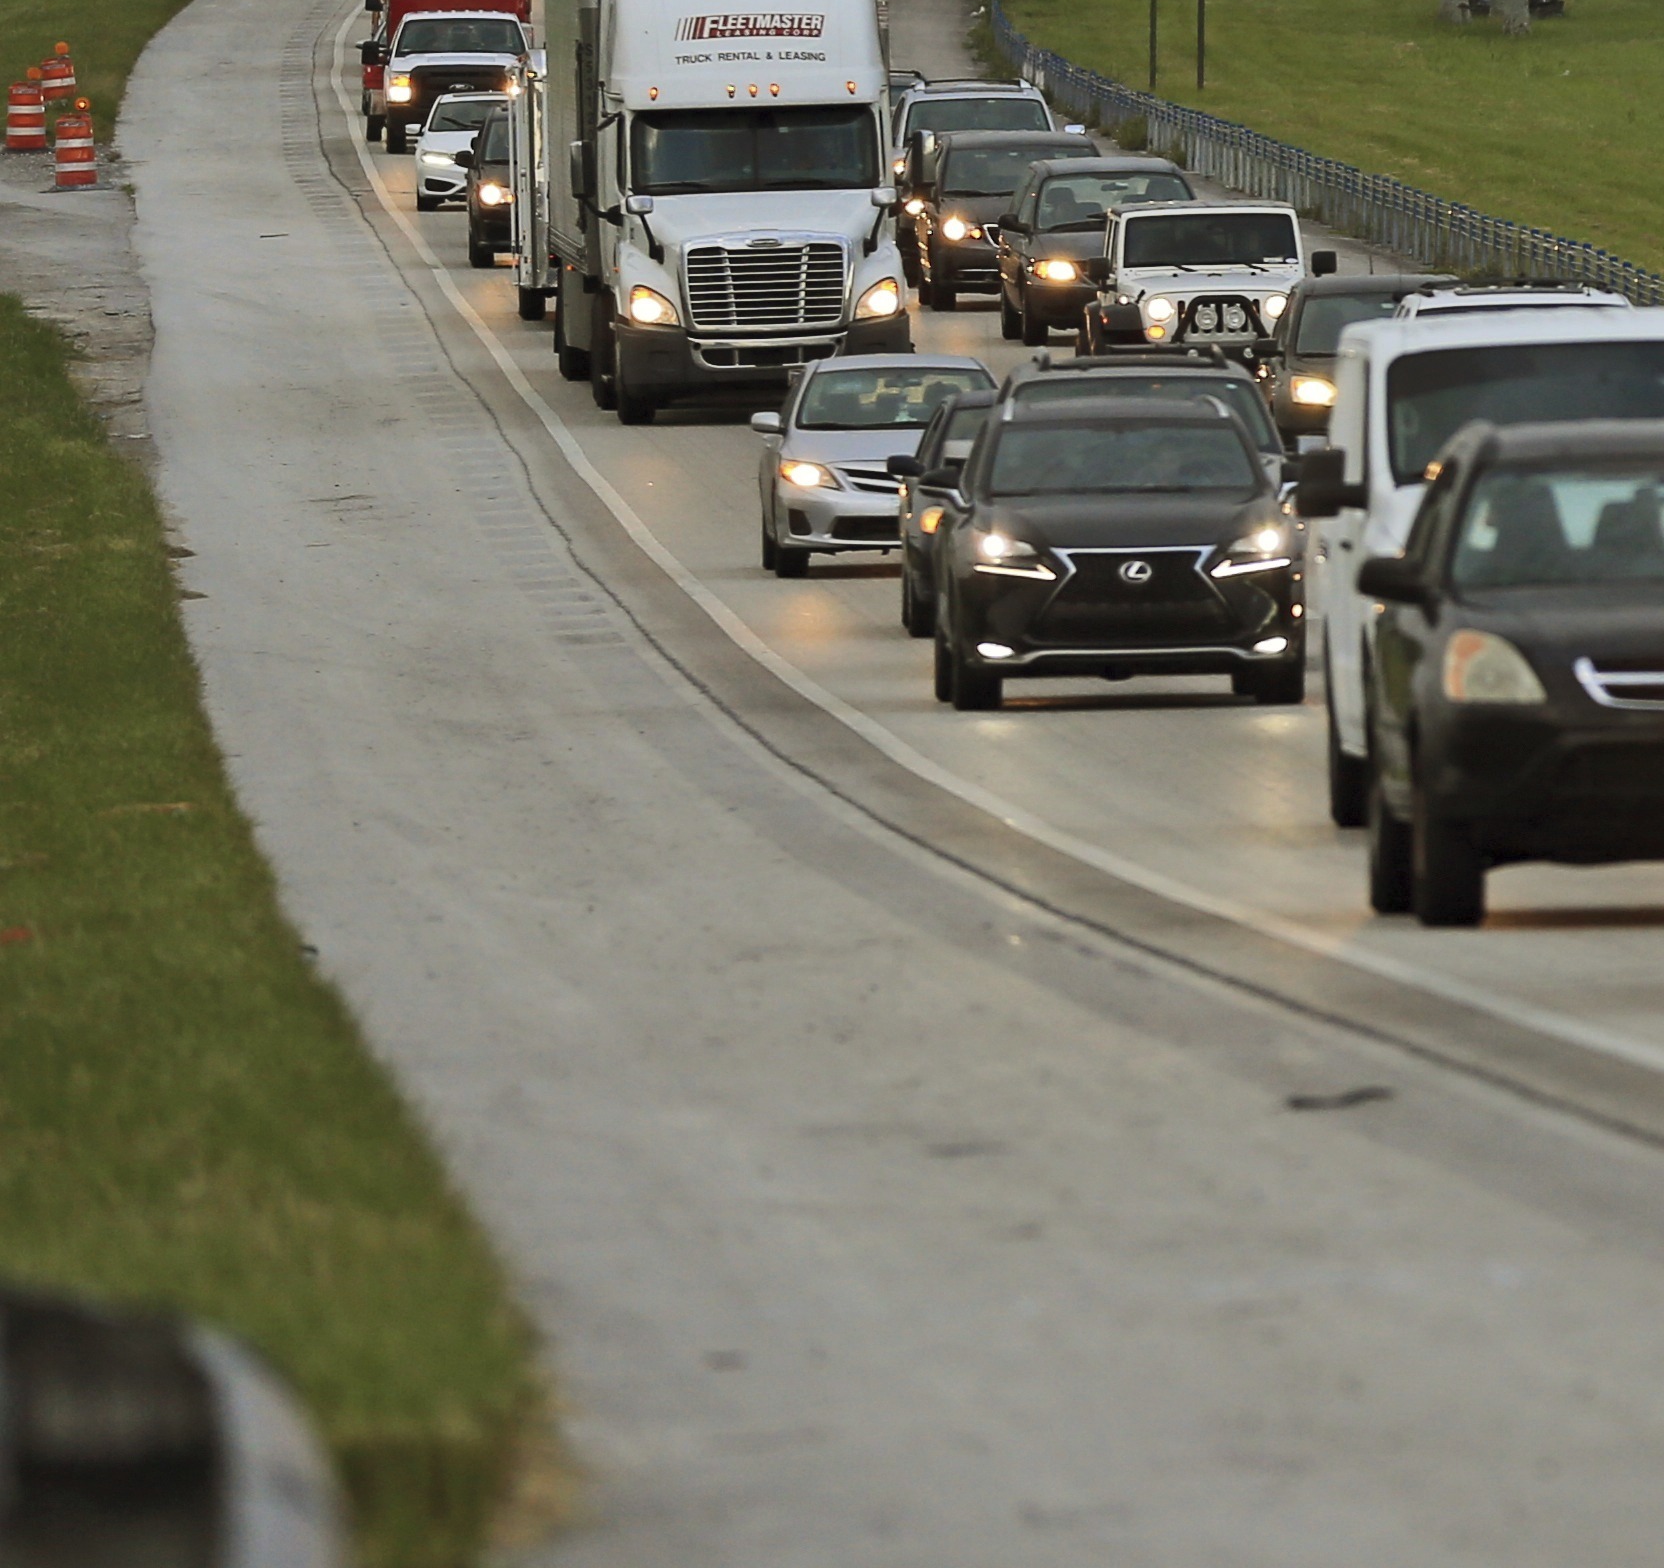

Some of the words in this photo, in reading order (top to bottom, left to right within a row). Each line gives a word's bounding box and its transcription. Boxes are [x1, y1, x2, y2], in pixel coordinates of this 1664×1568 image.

[702, 14, 822, 38] FLEETMASTER
[716, 29, 776, 37] LEASING
[675, 53, 712, 65] TRUCK
[718, 51, 760, 62] RENTAL
[766, 51, 773, 60] &
[779, 51, 826, 62] LEASING
